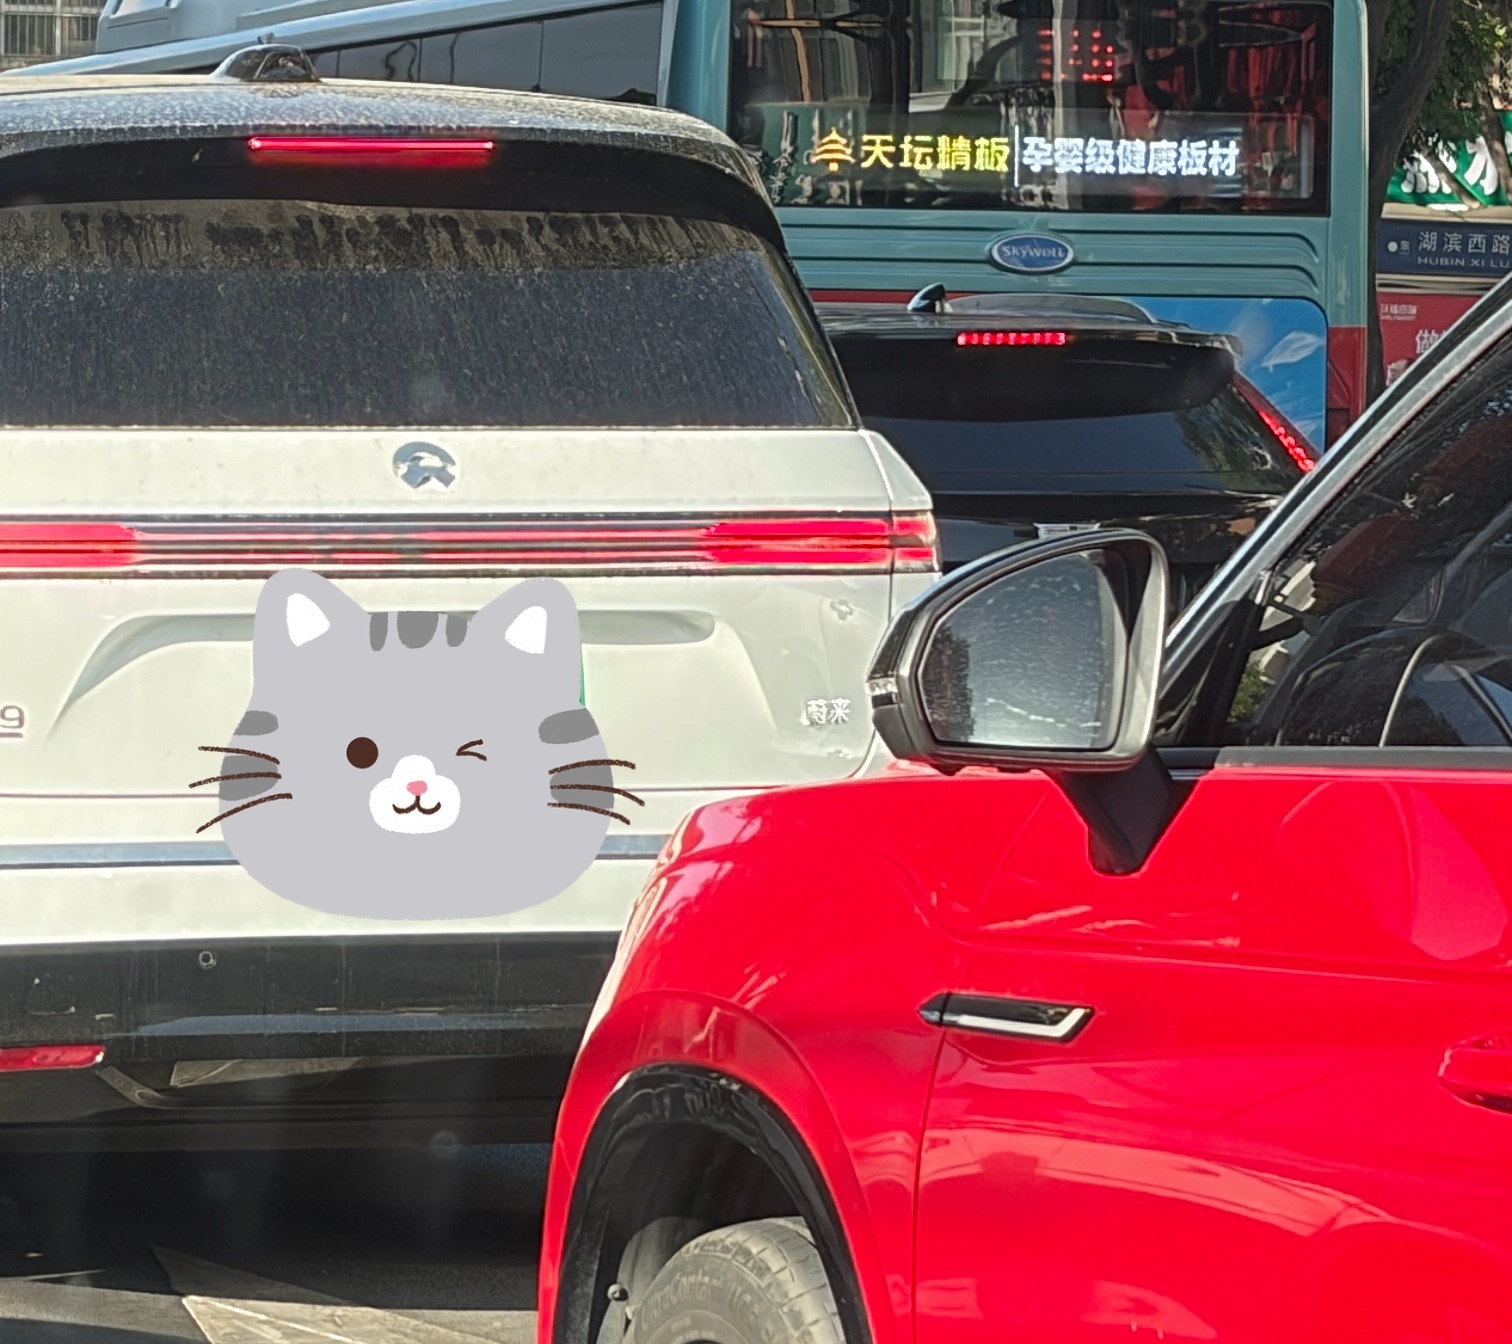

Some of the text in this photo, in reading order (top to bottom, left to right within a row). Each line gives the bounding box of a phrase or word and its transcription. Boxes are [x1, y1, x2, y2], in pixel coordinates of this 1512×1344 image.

[860, 134, 1240, 176] 天坛精板 孕婴级健康板材
[1418, 231, 1510, 254] 湖滨西路
[1417, 256, 1510, 268] HUBIN XI LU
